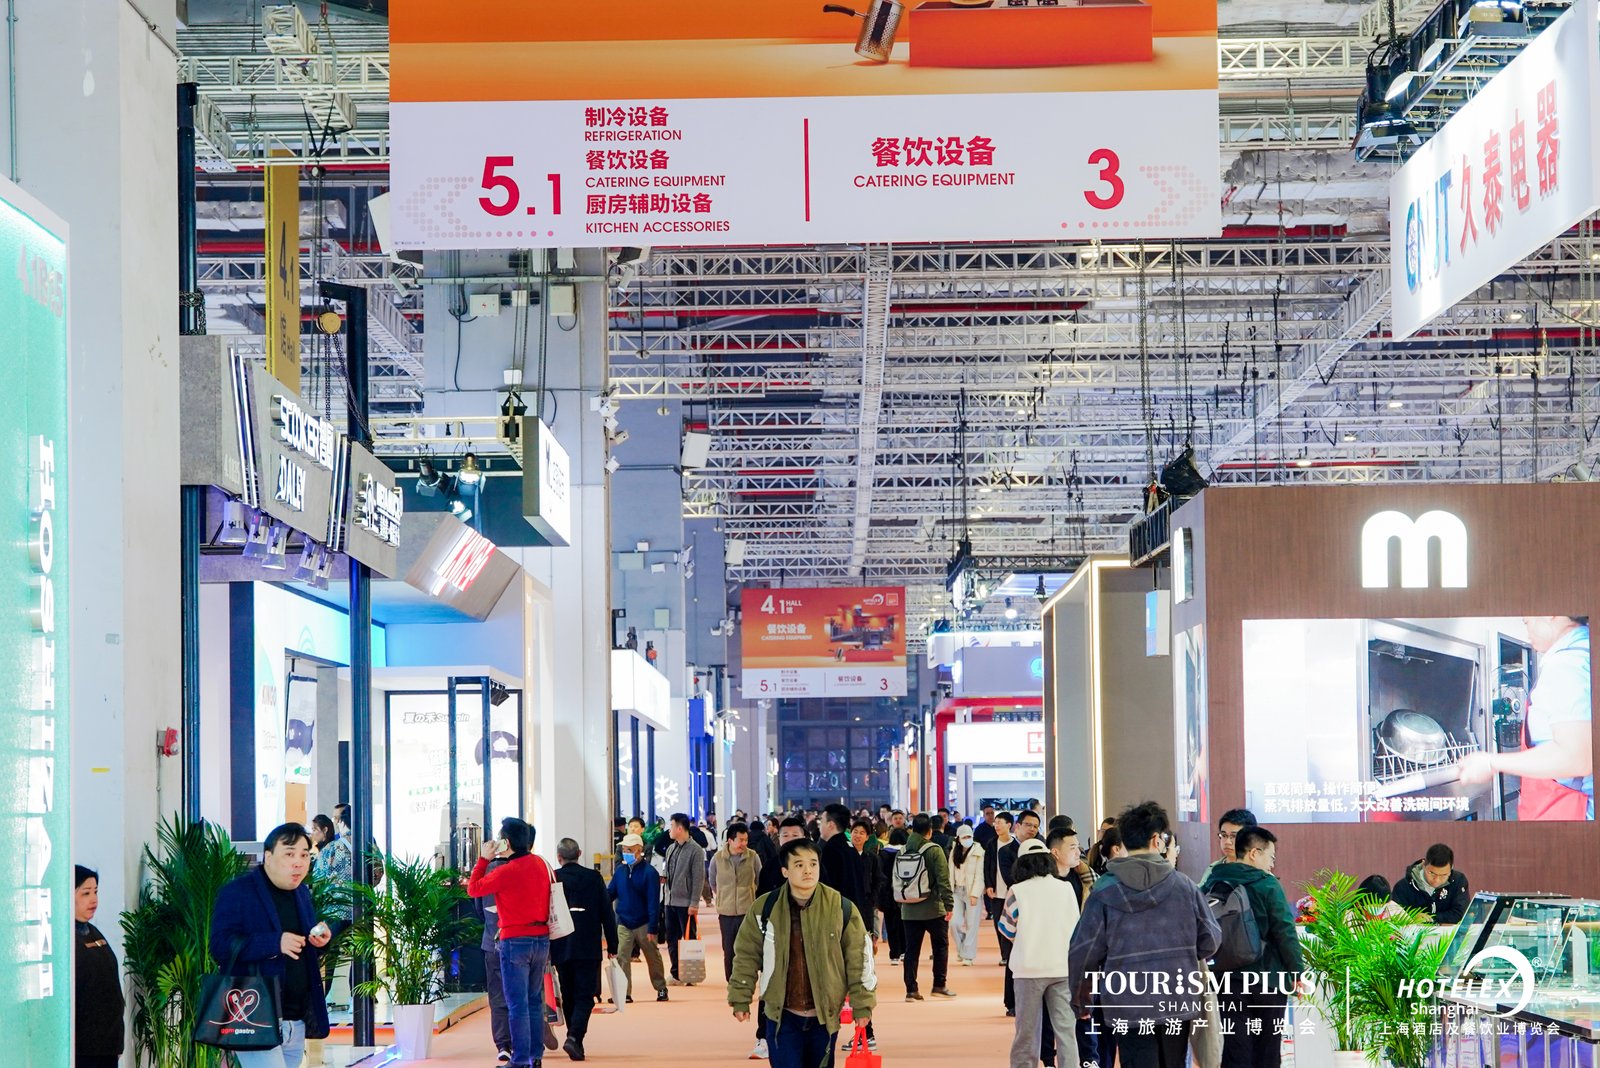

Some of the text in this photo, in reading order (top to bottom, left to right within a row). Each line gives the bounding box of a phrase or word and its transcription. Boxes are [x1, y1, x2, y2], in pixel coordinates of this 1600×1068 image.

[585, 106, 668, 127] 制冷设备
[585, 129, 682, 142] REFRIGERATION
[585, 149, 670, 170] 餐饮设备
[872, 136, 996, 167] 餐饮设备
[1460, 80, 1561, 256] 久泰电器
[479, 156, 561, 217] 5.1
[585, 175, 725, 188] CATERING EQUIPMENT
[854, 172, 1015, 188] CATERING EQUIPMENT
[1084, 148, 1124, 210] 3
[586, 193, 713, 214] 厨房辅助设备
[586, 220, 730, 233] KITCHEN ACCESSORIES
[761, 595, 785, 614] 4.1
[880, 678, 888, 691] 3
